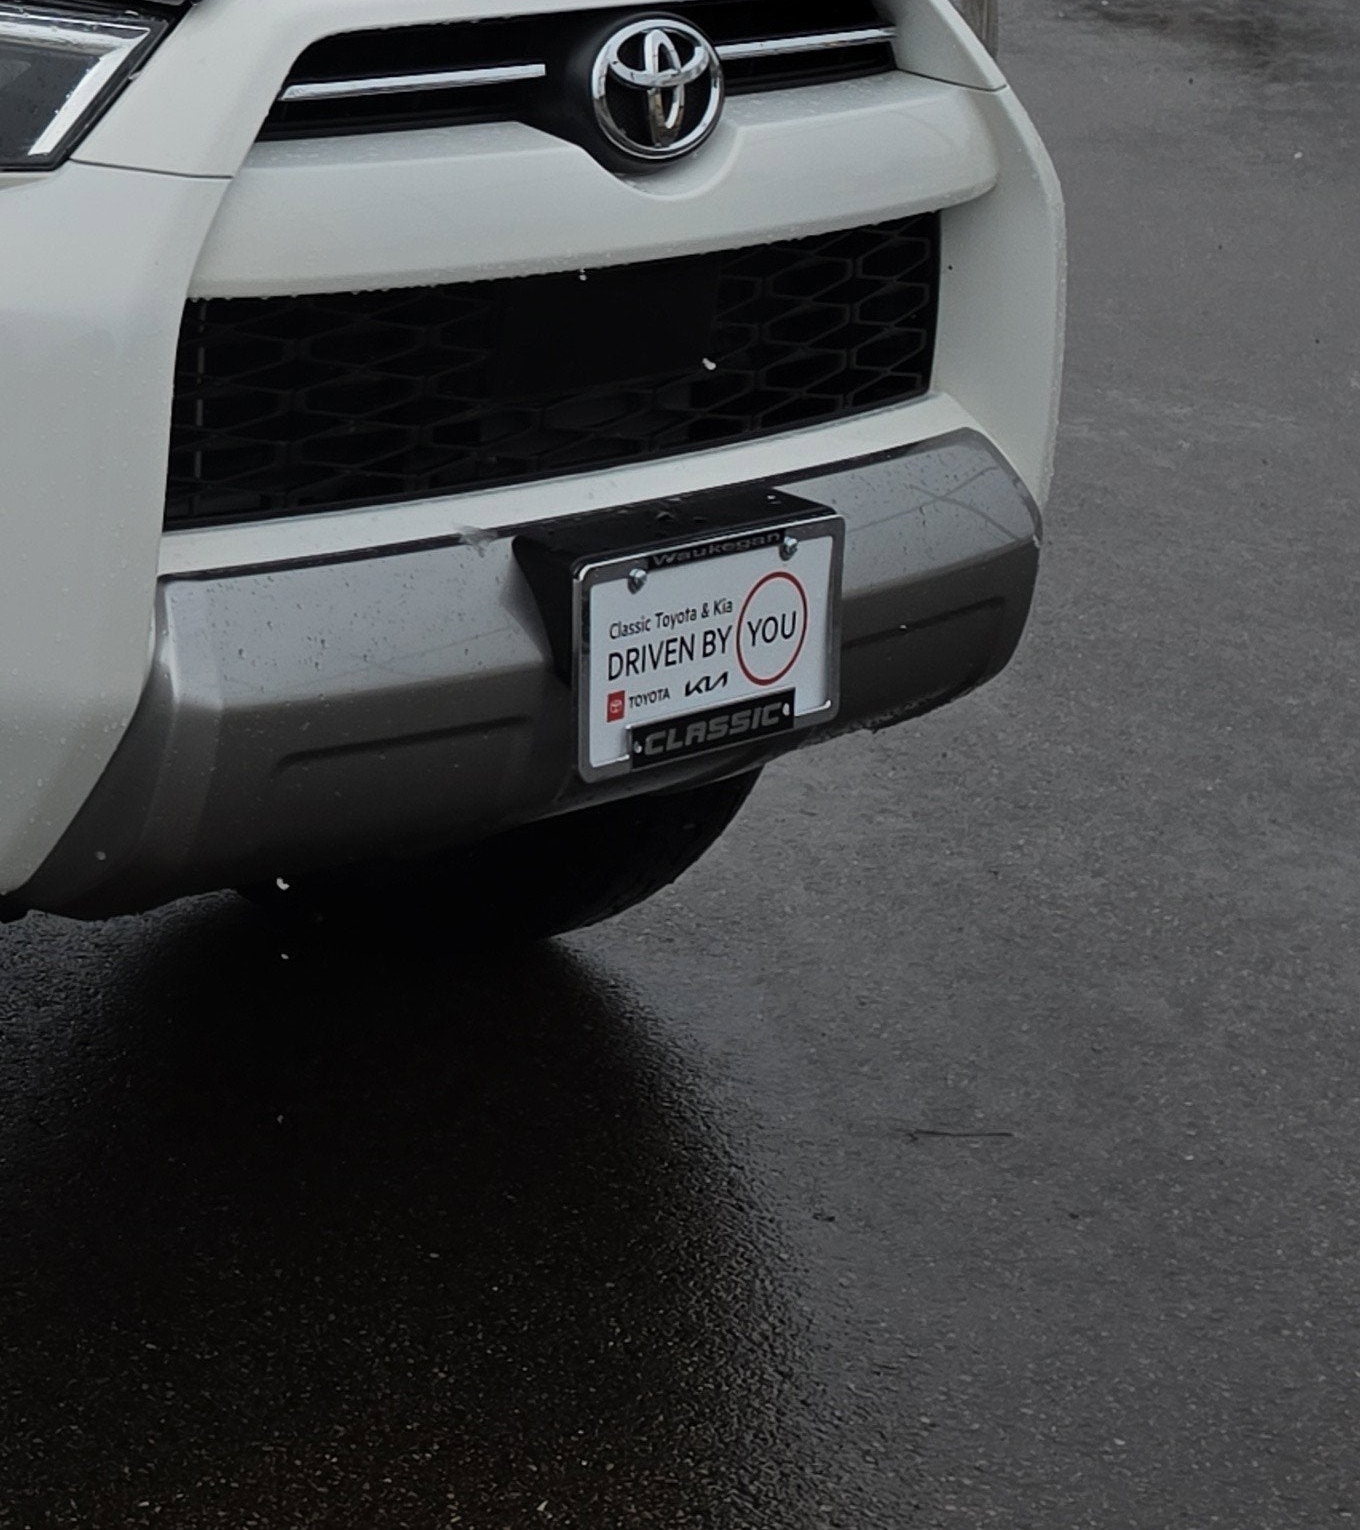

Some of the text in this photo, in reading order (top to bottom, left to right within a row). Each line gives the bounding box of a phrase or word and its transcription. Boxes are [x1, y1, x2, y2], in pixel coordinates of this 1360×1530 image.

[651, 531, 781, 566] Waukegan
[609, 597, 733, 640] Classic Toyota & Kia
[608, 610, 797, 681] DRIVEN BY YOU
[629, 687, 670, 709] TOYOTA
[644, 702, 782, 756] CLASSIC
